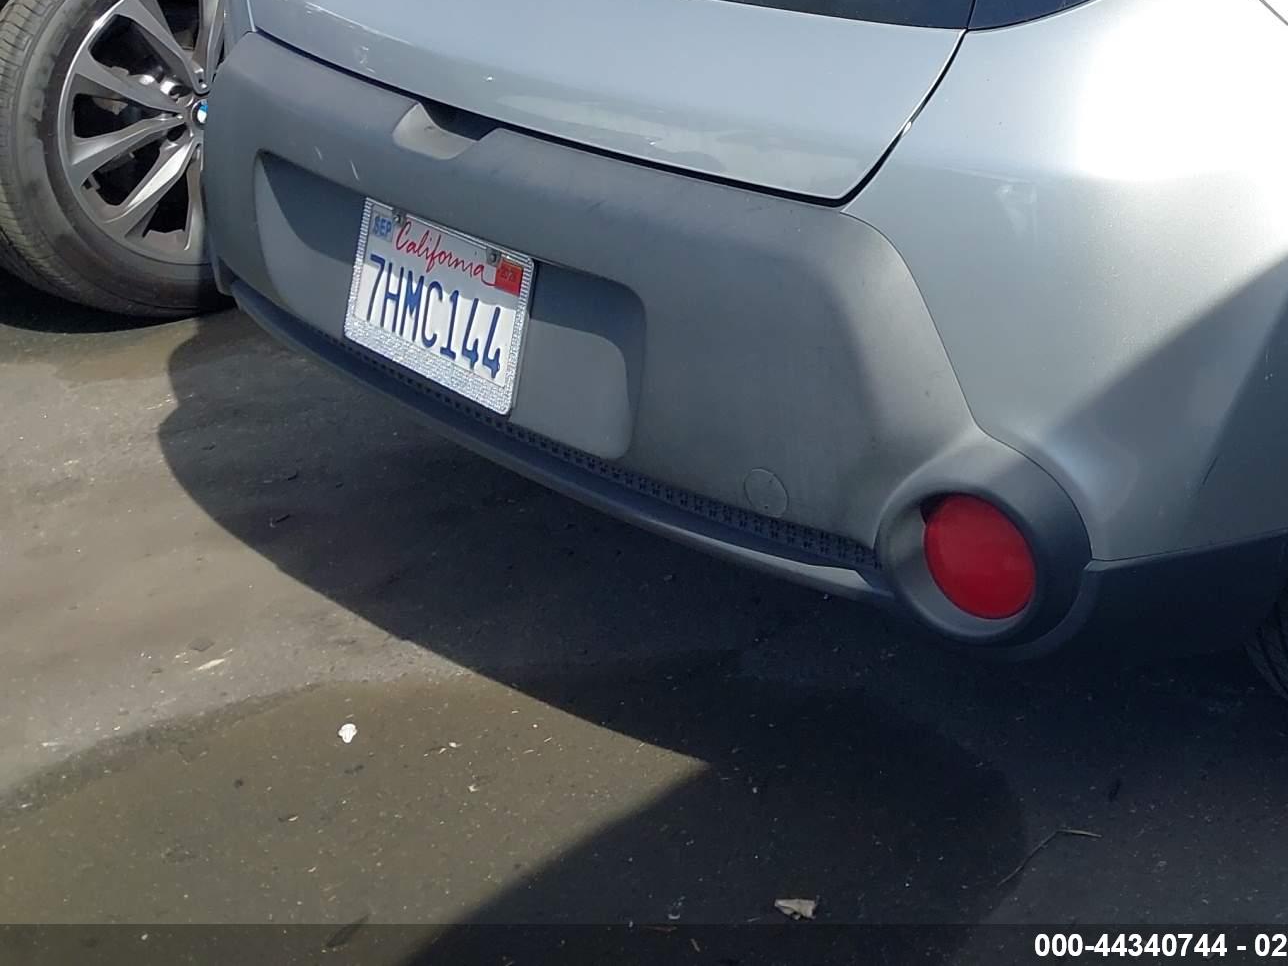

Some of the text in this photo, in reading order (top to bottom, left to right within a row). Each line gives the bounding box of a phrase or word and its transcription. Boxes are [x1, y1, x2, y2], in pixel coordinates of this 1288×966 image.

[373, 215, 393, 236] SEP
[395, 221, 496, 287] California
[366, 254, 501, 379] 7HMC144
